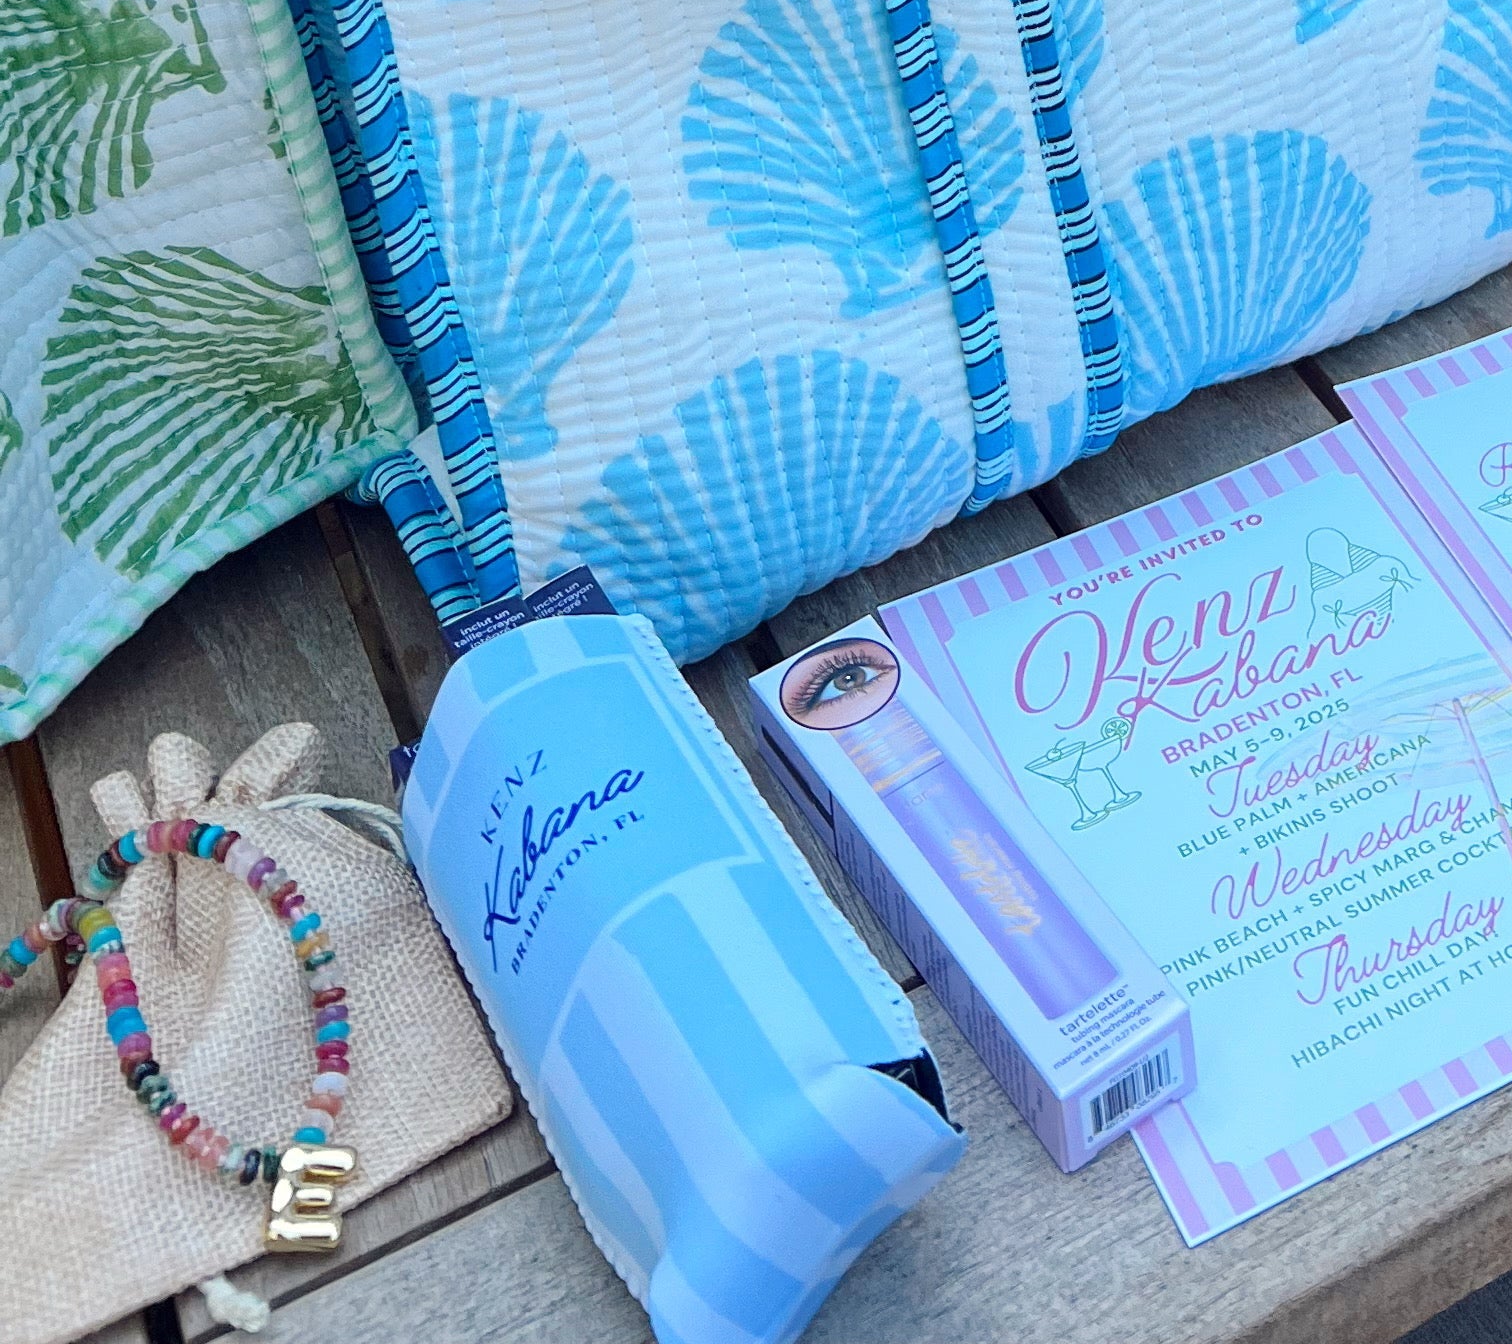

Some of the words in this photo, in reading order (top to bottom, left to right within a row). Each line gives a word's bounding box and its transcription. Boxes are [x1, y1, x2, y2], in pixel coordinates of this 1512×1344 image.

[565, 581, 580, 594] un
[1048, 565, 1134, 606] YOU'RE
[1138, 529, 1226, 570] INVITED
[1229, 514, 1263, 532] TO
[459, 617, 495, 636] inclut
[494, 609, 511, 621] un
[1015, 566, 1297, 730] Kenz
[1116, 610, 1392, 751] Kabana
[1161, 682, 1329, 764] BRADENTON,
[1329, 667, 1364, 689] FL
[1189, 746, 1237, 778] MAY
[1294, 698, 1349, 732] 2025
[1206, 729, 1379, 817] Tuesday
[480, 748, 548, 845] KENZ
[613, 810, 646, 831] FL
[1177, 825, 1231, 858] BLUE
[1233, 797, 1292, 832] PALM
[1314, 734, 1432, 796] AMERICANA
[1253, 808, 1326, 849] BIKINIS
[1329, 772, 1398, 814] SHOOT
[483, 768, 645, 974] Kabana
[1210, 789, 1472, 920] Wednesday
[1159, 946, 1212, 976] PINK
[1213, 909, 1288, 954] BEACH
[1308, 869, 1367, 907] SPICY
[1372, 839, 1436, 877] MARG
[1186, 915, 1342, 997] PINK/NEUTRAL
[1344, 868, 1435, 919] SUMMER
[1293, 891, 1505, 1005] Thursday
[1291, 1012, 1383, 1068] HIBACHI
[1385, 976, 1451, 1020] NIGHT
[1458, 960, 1484, 985] AT
[1333, 983, 1380, 1016] FUN
[1382, 954, 1445, 990] CHILL
